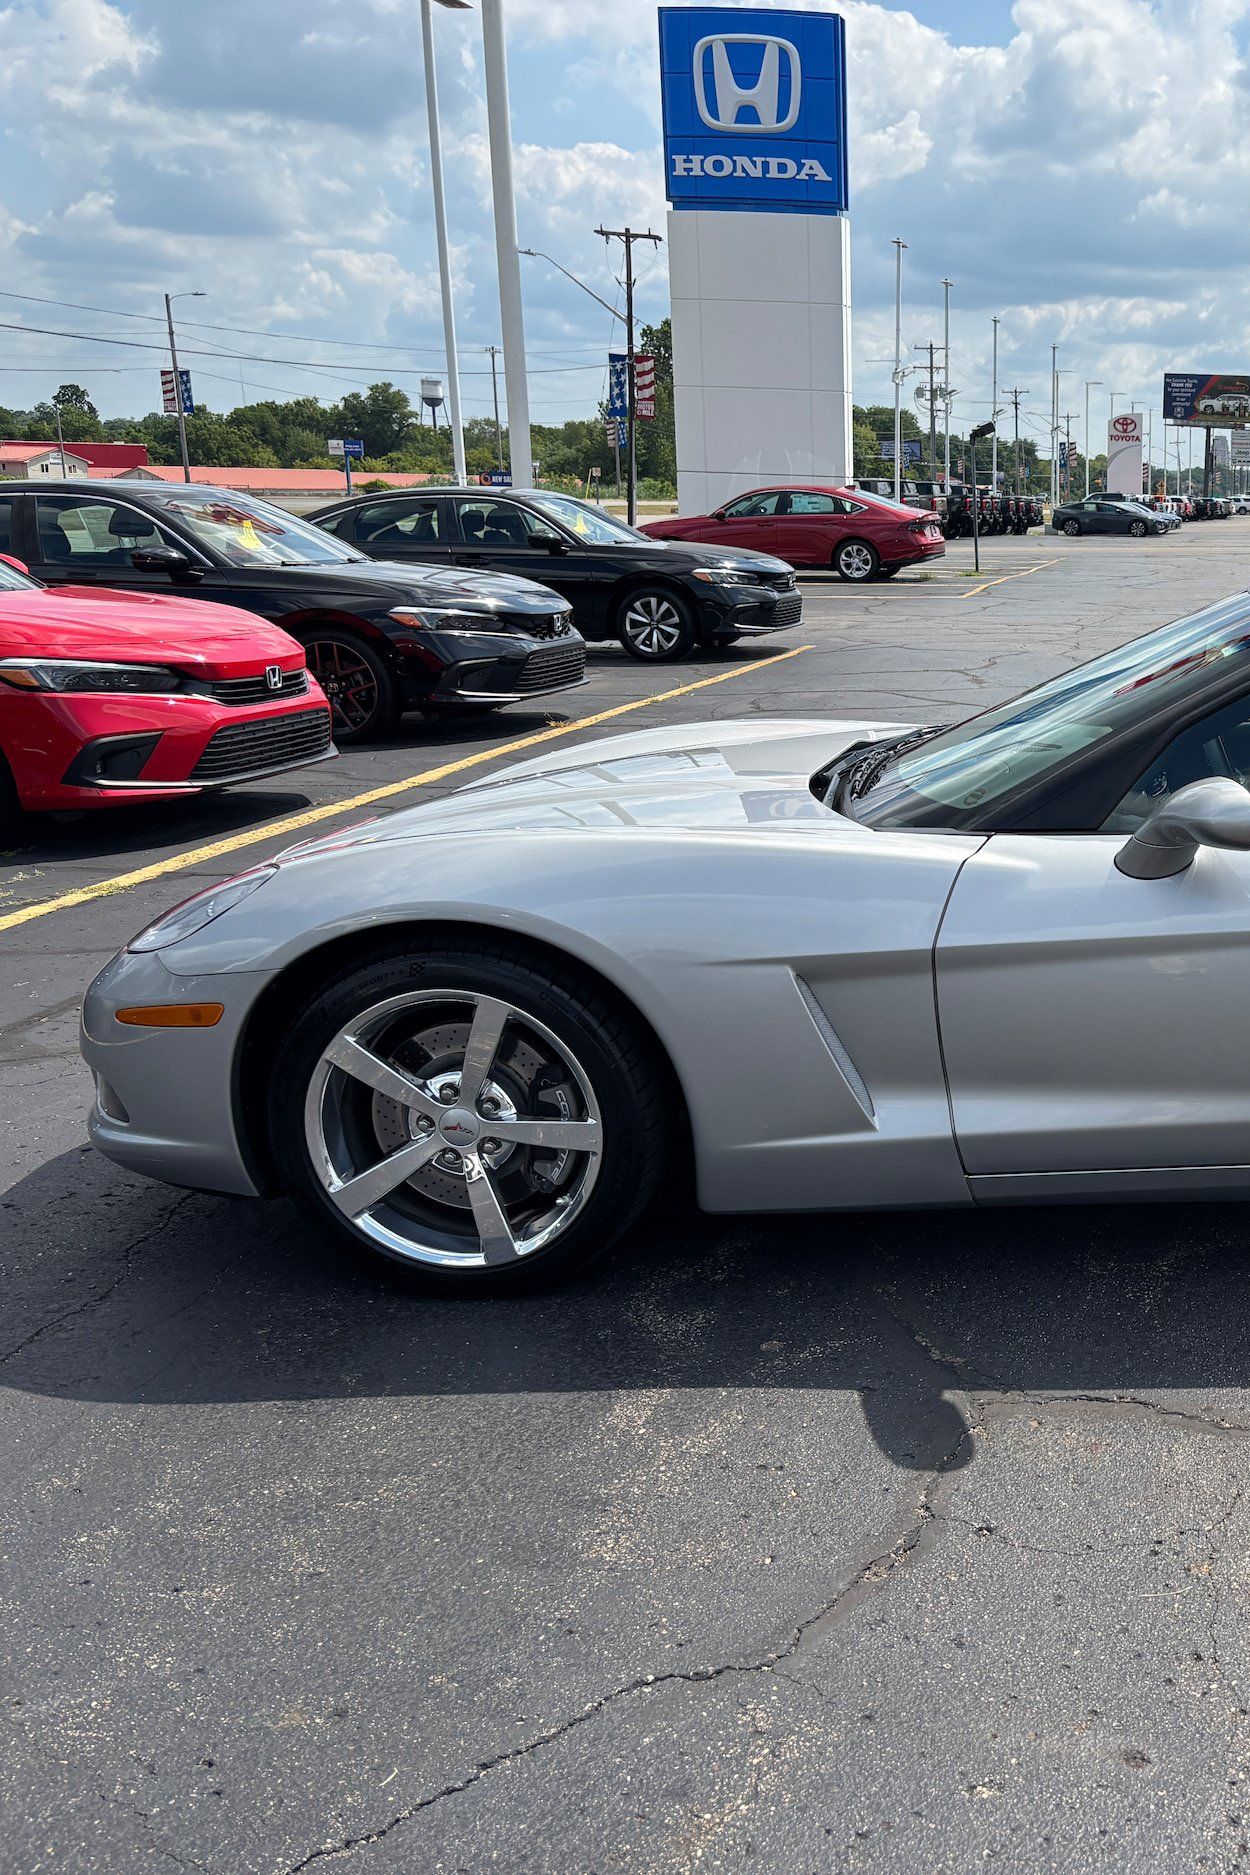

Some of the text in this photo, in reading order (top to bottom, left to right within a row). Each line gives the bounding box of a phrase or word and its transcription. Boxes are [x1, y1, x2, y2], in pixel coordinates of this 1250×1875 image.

[671, 154, 833, 182] HONDA
[1109, 434, 1141, 442] TOYOTA
[550, 1090, 571, 1181] COTTE
